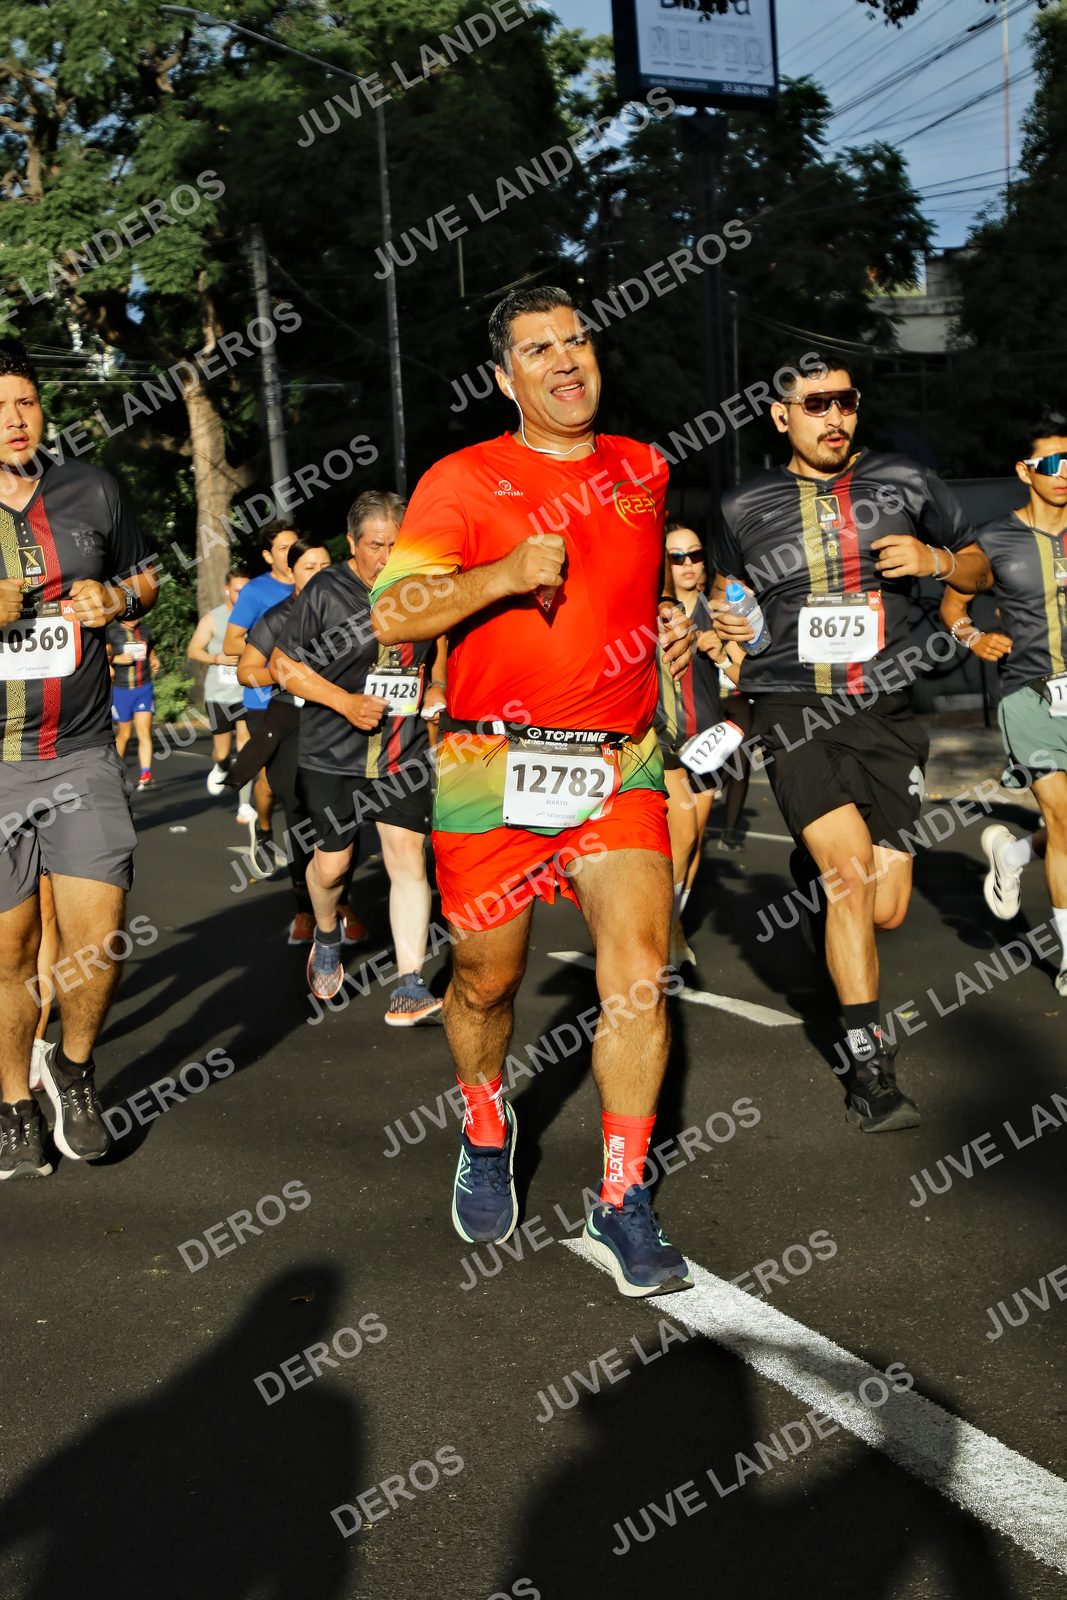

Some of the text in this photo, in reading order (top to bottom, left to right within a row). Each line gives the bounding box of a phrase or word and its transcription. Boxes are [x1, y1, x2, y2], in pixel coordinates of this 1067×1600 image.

[809, 615, 865, 638] 8675
[370, 682, 418, 698] 11428
[545, 730, 608, 743] TOPTIME
[689, 724, 727, 766] 11229
[512, 763, 606, 798] 12782
